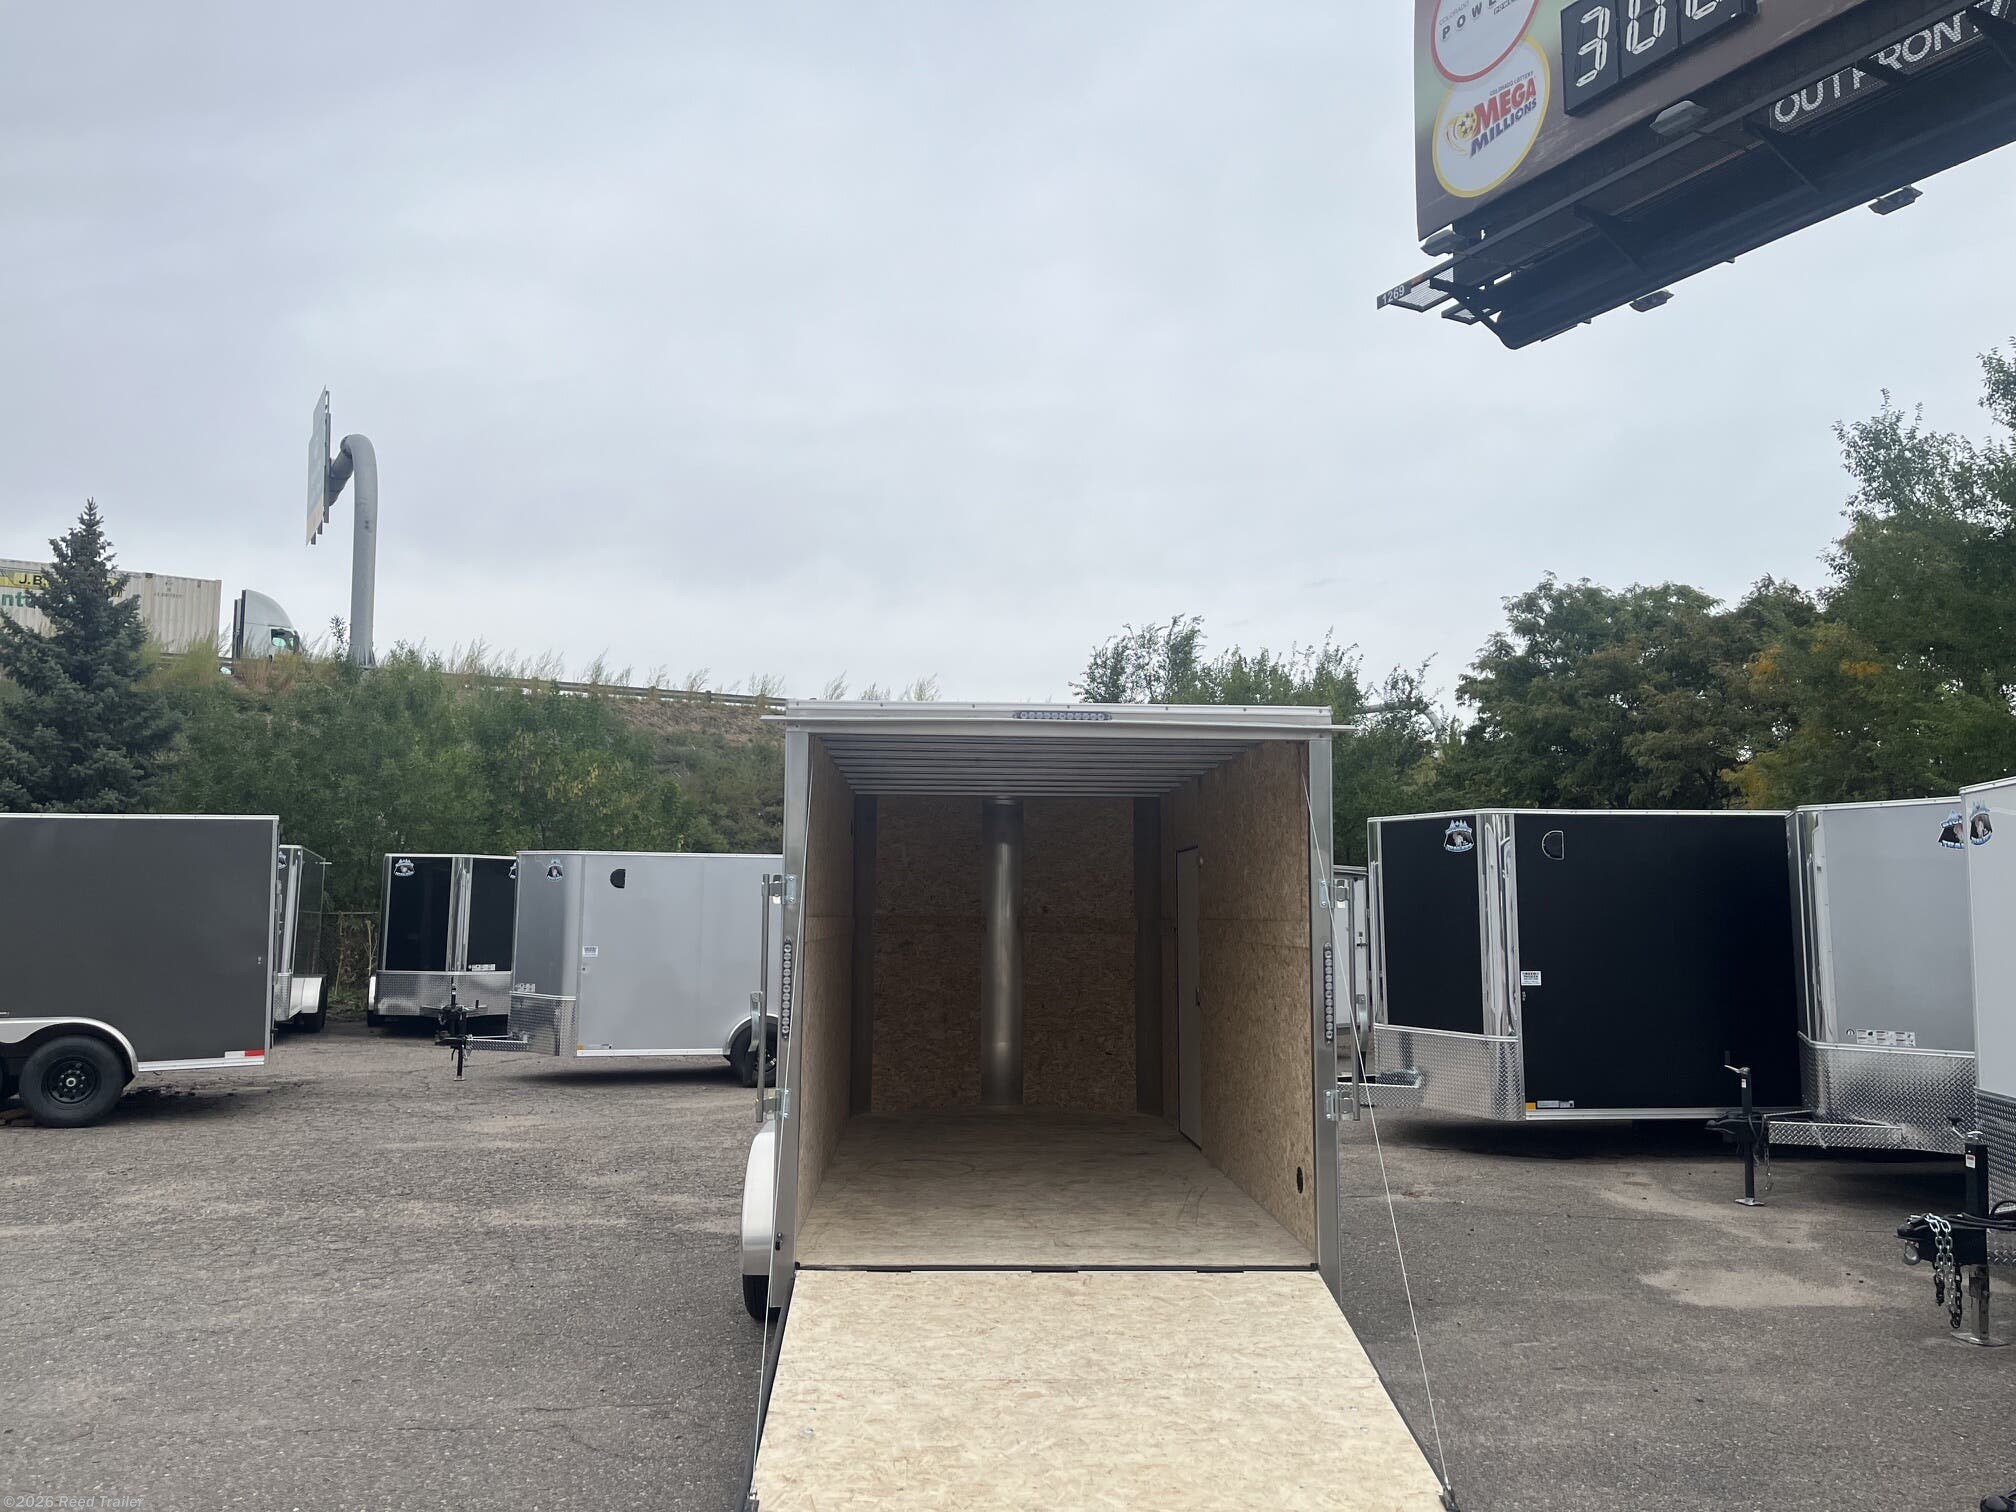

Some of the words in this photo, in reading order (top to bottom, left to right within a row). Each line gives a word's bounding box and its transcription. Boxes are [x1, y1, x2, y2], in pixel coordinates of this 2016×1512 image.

[1470, 97, 1537, 157] MILLIONS
[1472, 77, 1537, 138] MEGA
[1382, 284, 1405, 304] 1269
